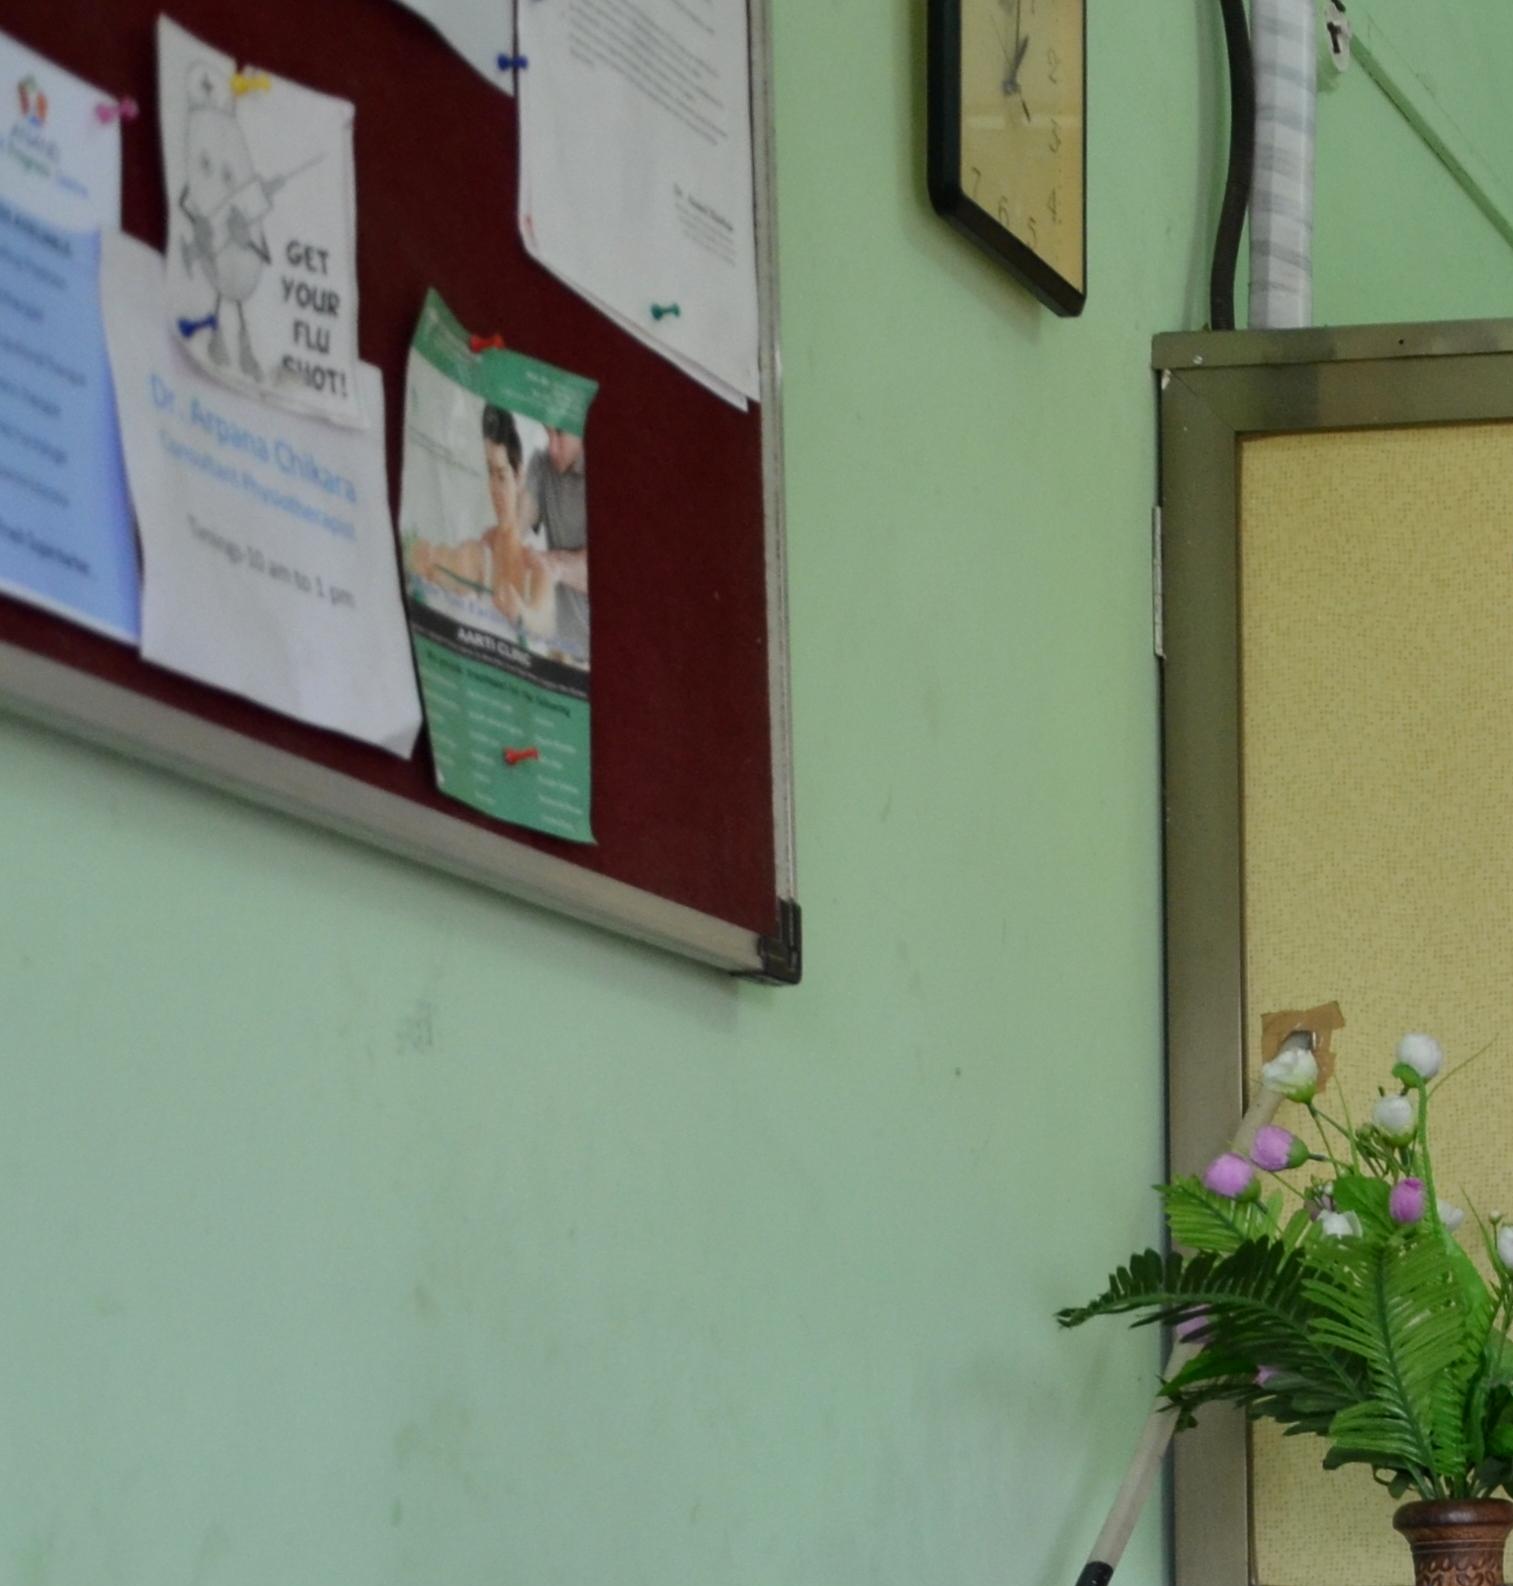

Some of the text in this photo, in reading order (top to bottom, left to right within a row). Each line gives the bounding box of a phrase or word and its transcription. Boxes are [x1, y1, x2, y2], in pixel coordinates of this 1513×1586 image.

[286, 239, 329, 275] GET
[282, 275, 341, 316] YOUR
[293, 319, 330, 354] FLU
[281, 354, 348, 398] SHOT!
[456, 627, 532, 667] AARTI CLINIC
